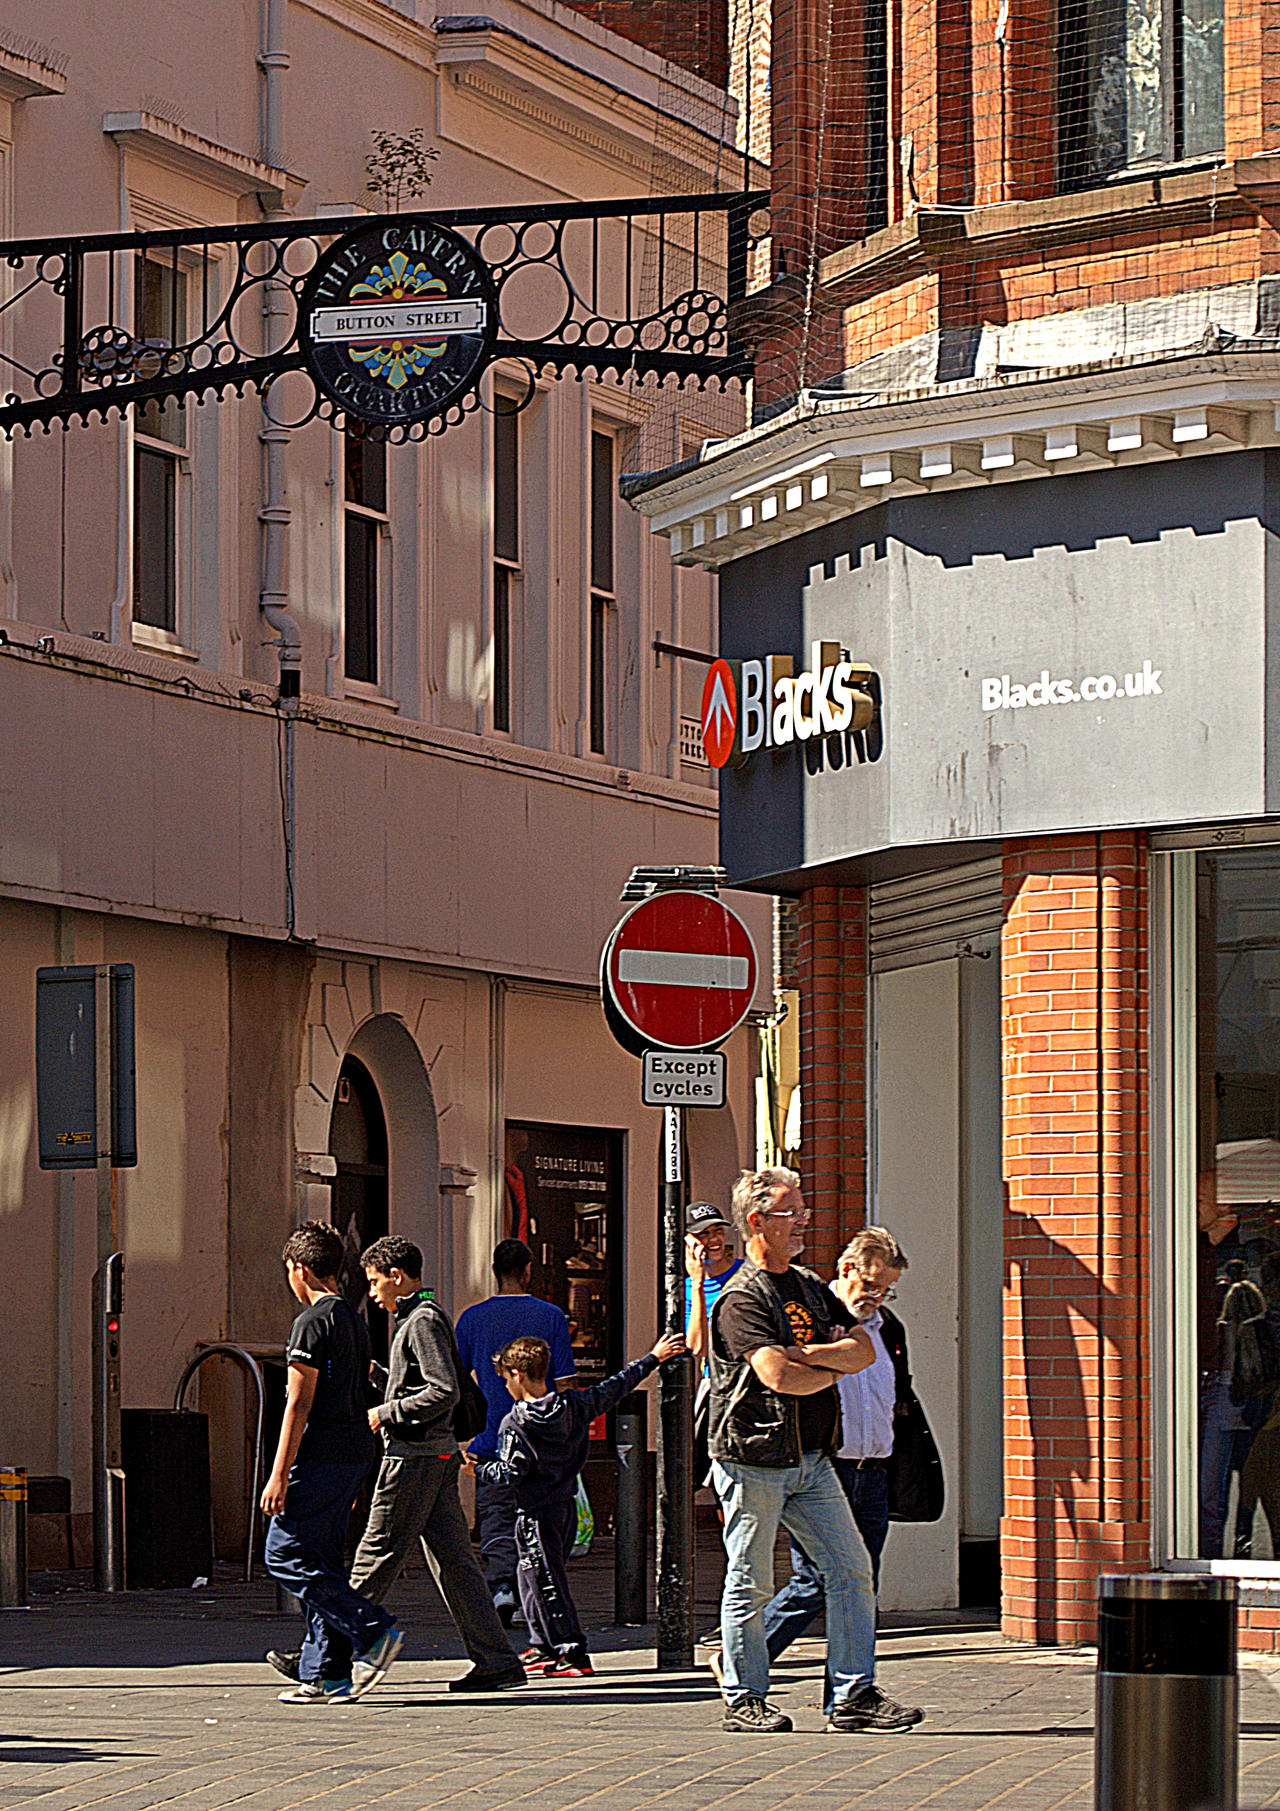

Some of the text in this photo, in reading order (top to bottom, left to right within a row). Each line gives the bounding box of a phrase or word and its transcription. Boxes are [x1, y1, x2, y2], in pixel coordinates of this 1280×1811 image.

[315, 227, 482, 299] THE CAVERN
[336, 311, 462, 331] BUTTON STREET
[334, 367, 463, 413] QUARTER
[741, 640, 854, 753] Blacks
[981, 659, 1164, 712] Blacks.co.uk
[651, 1057, 718, 1078] Except
[652, 1079, 714, 1098] cycles
[535, 1155, 578, 1172] SIGNATURE
